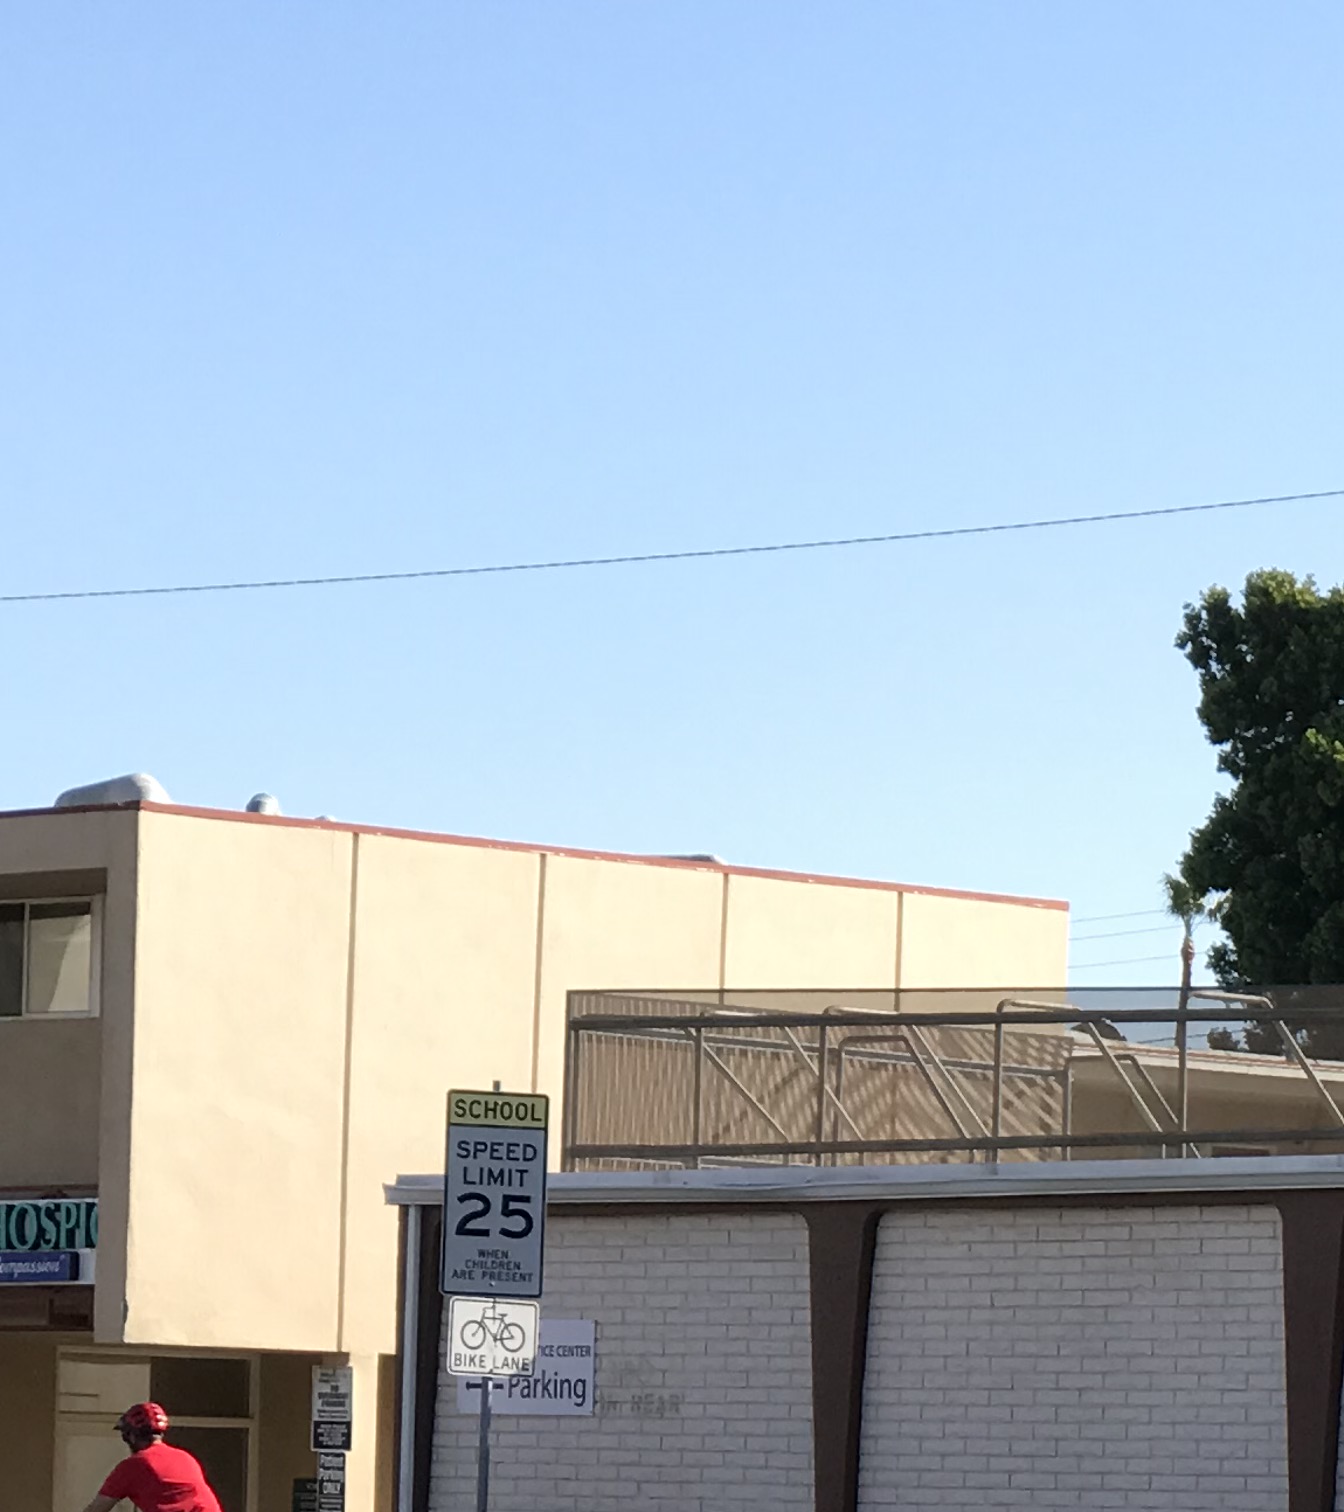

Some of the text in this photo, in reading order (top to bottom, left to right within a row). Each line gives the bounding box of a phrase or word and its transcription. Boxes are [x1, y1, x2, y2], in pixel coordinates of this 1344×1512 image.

[454, 1098, 542, 1122] SCHOOL
[456, 1140, 537, 1162] SPEED
[463, 1166, 529, 1188] LIMIT
[455, 1192, 534, 1239] 25
[477, 1249, 509, 1259] WHEN
[464, 1259, 521, 1271] CHILDREN
[451, 1269, 533, 1283] ARE PRESENT
[556, 1345, 591, 1357] CENTER
[454, 1353, 530, 1371] BIKE LANE
[508, 1369, 586, 1407] Parking
